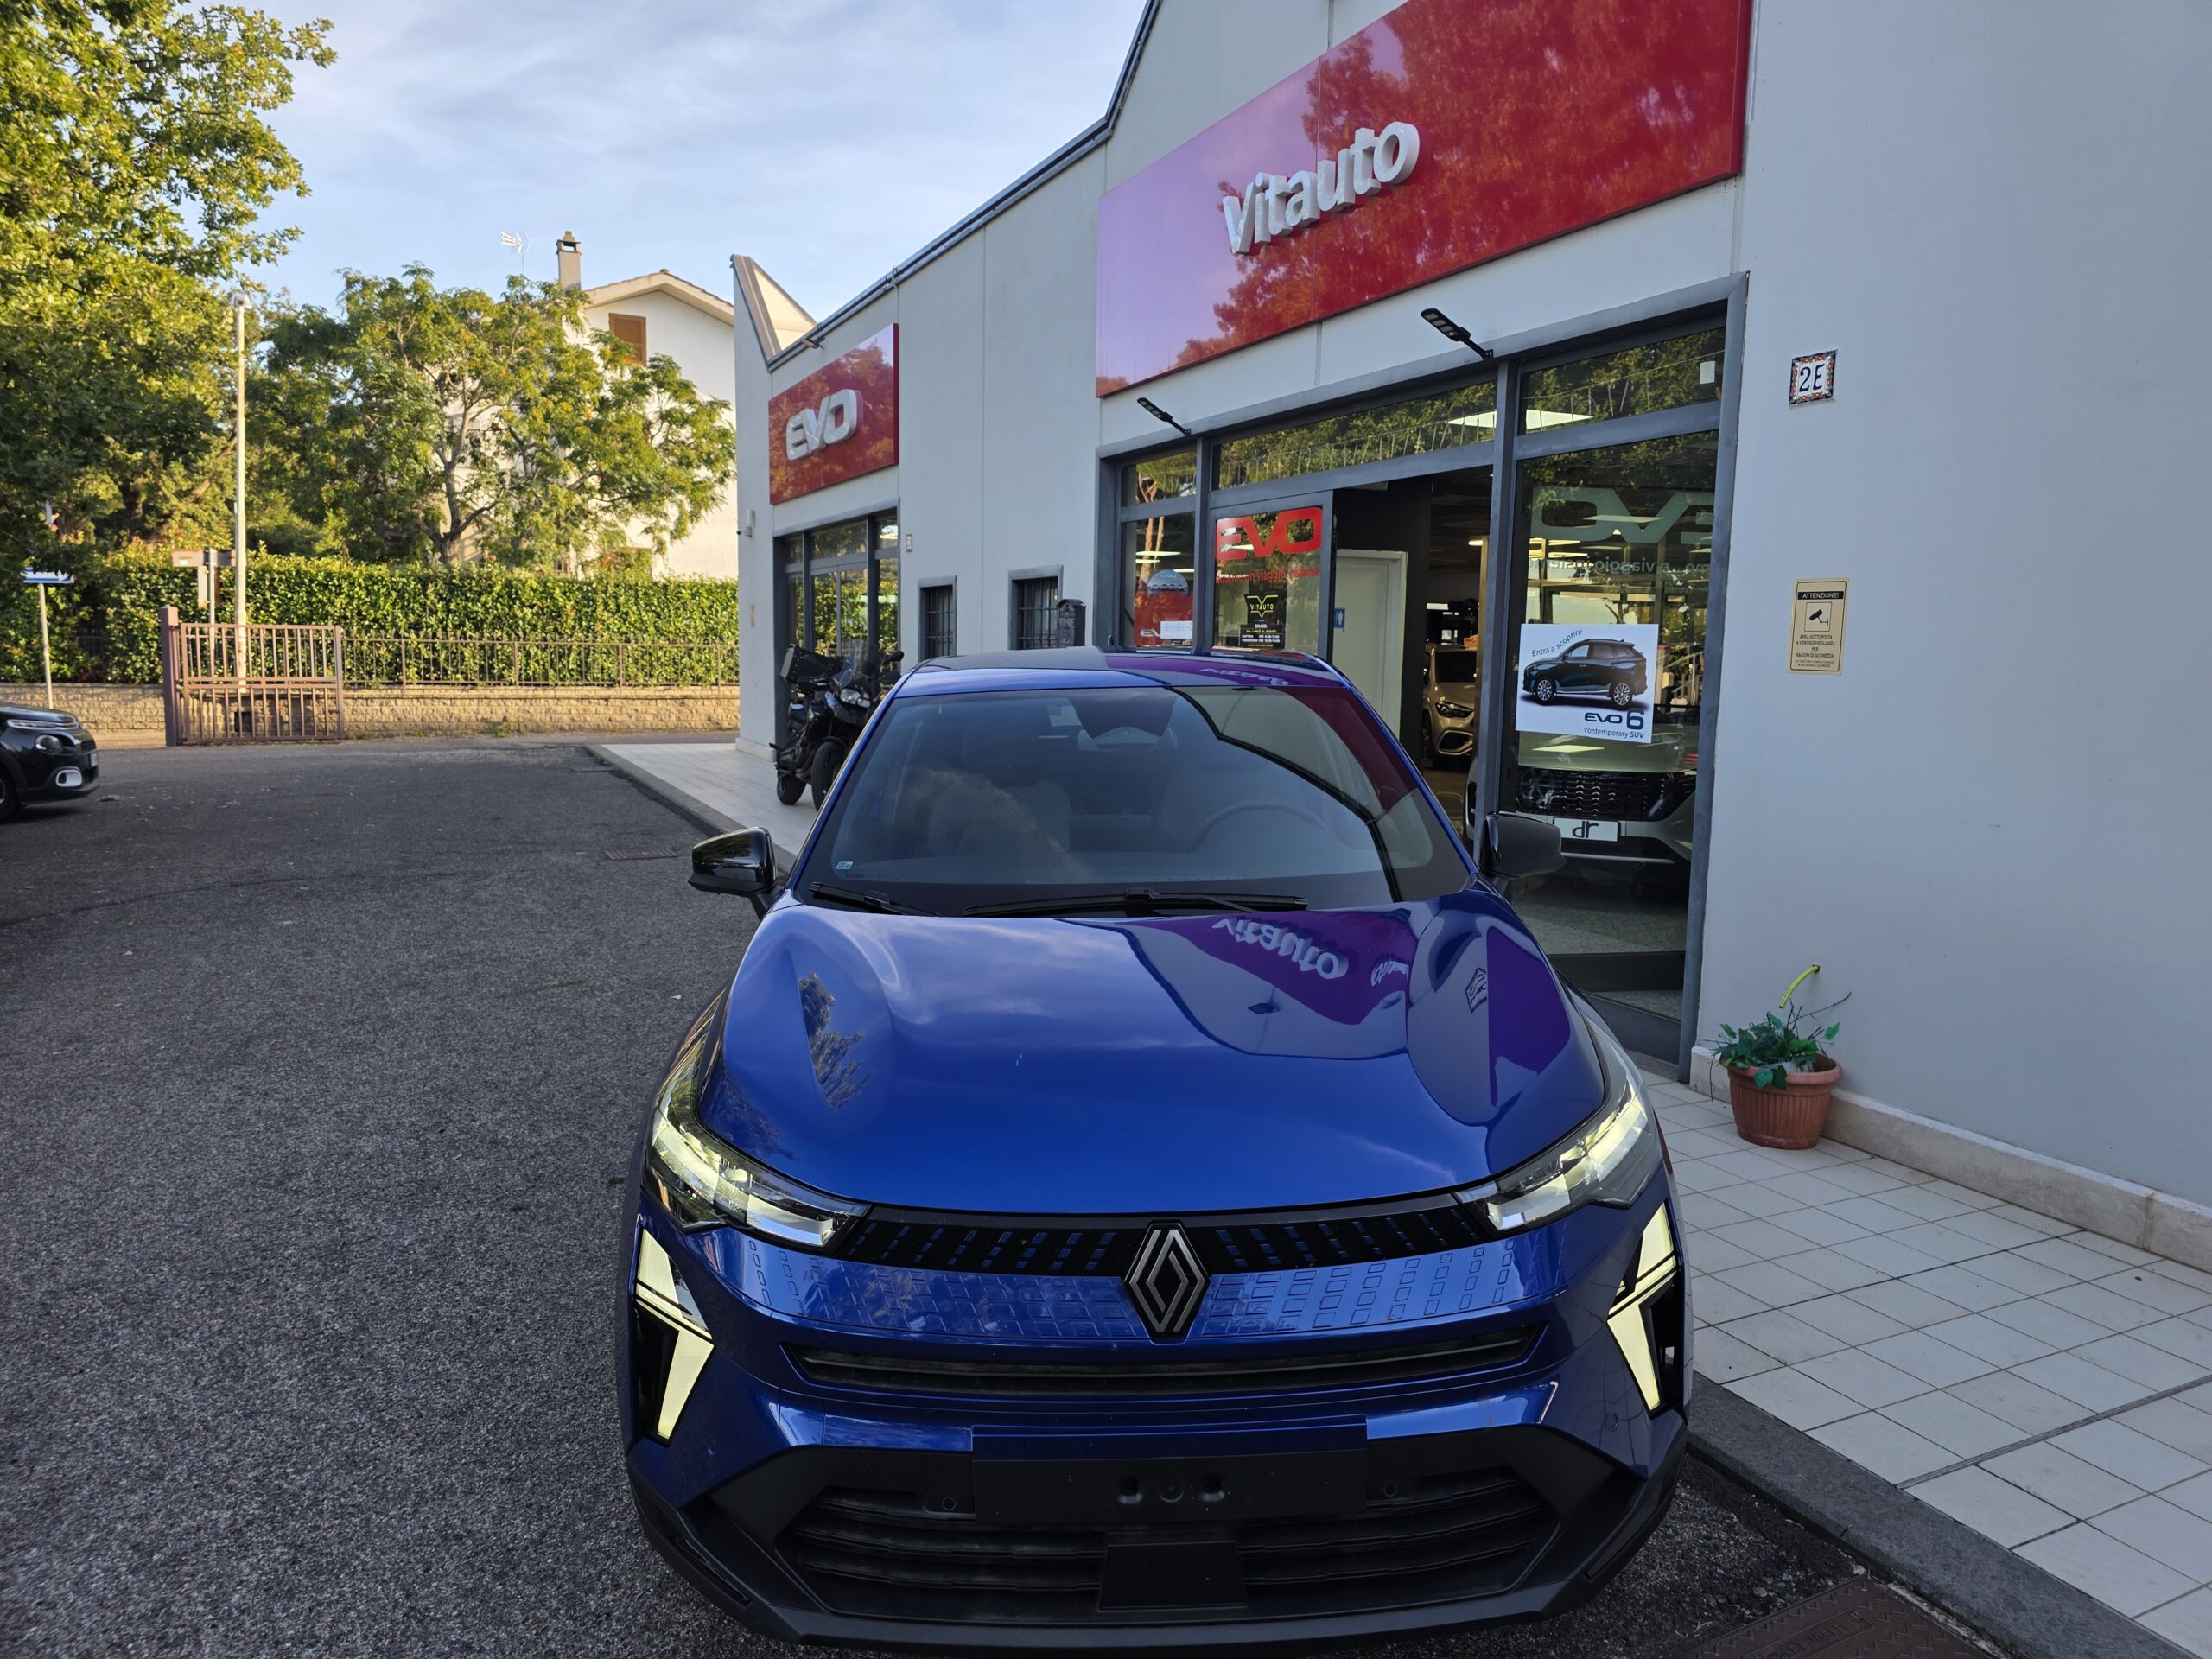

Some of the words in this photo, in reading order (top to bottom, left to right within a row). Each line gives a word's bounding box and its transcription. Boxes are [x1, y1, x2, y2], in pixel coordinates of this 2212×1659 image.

[1222, 121, 1420, 255] Vitauto
[1799, 363, 1825, 392] 2E
[786, 389, 857, 460] EVO
[1215, 506, 1323, 560] EVO
[1532, 646, 1549, 657] Entra
[1556, 629, 1583, 650] scoprire
[1585, 712, 1623, 724] EVO
[1626, 708, 1644, 730] 6
[1584, 728, 1629, 739] contemporary
[1572, 820, 1599, 838] dr
